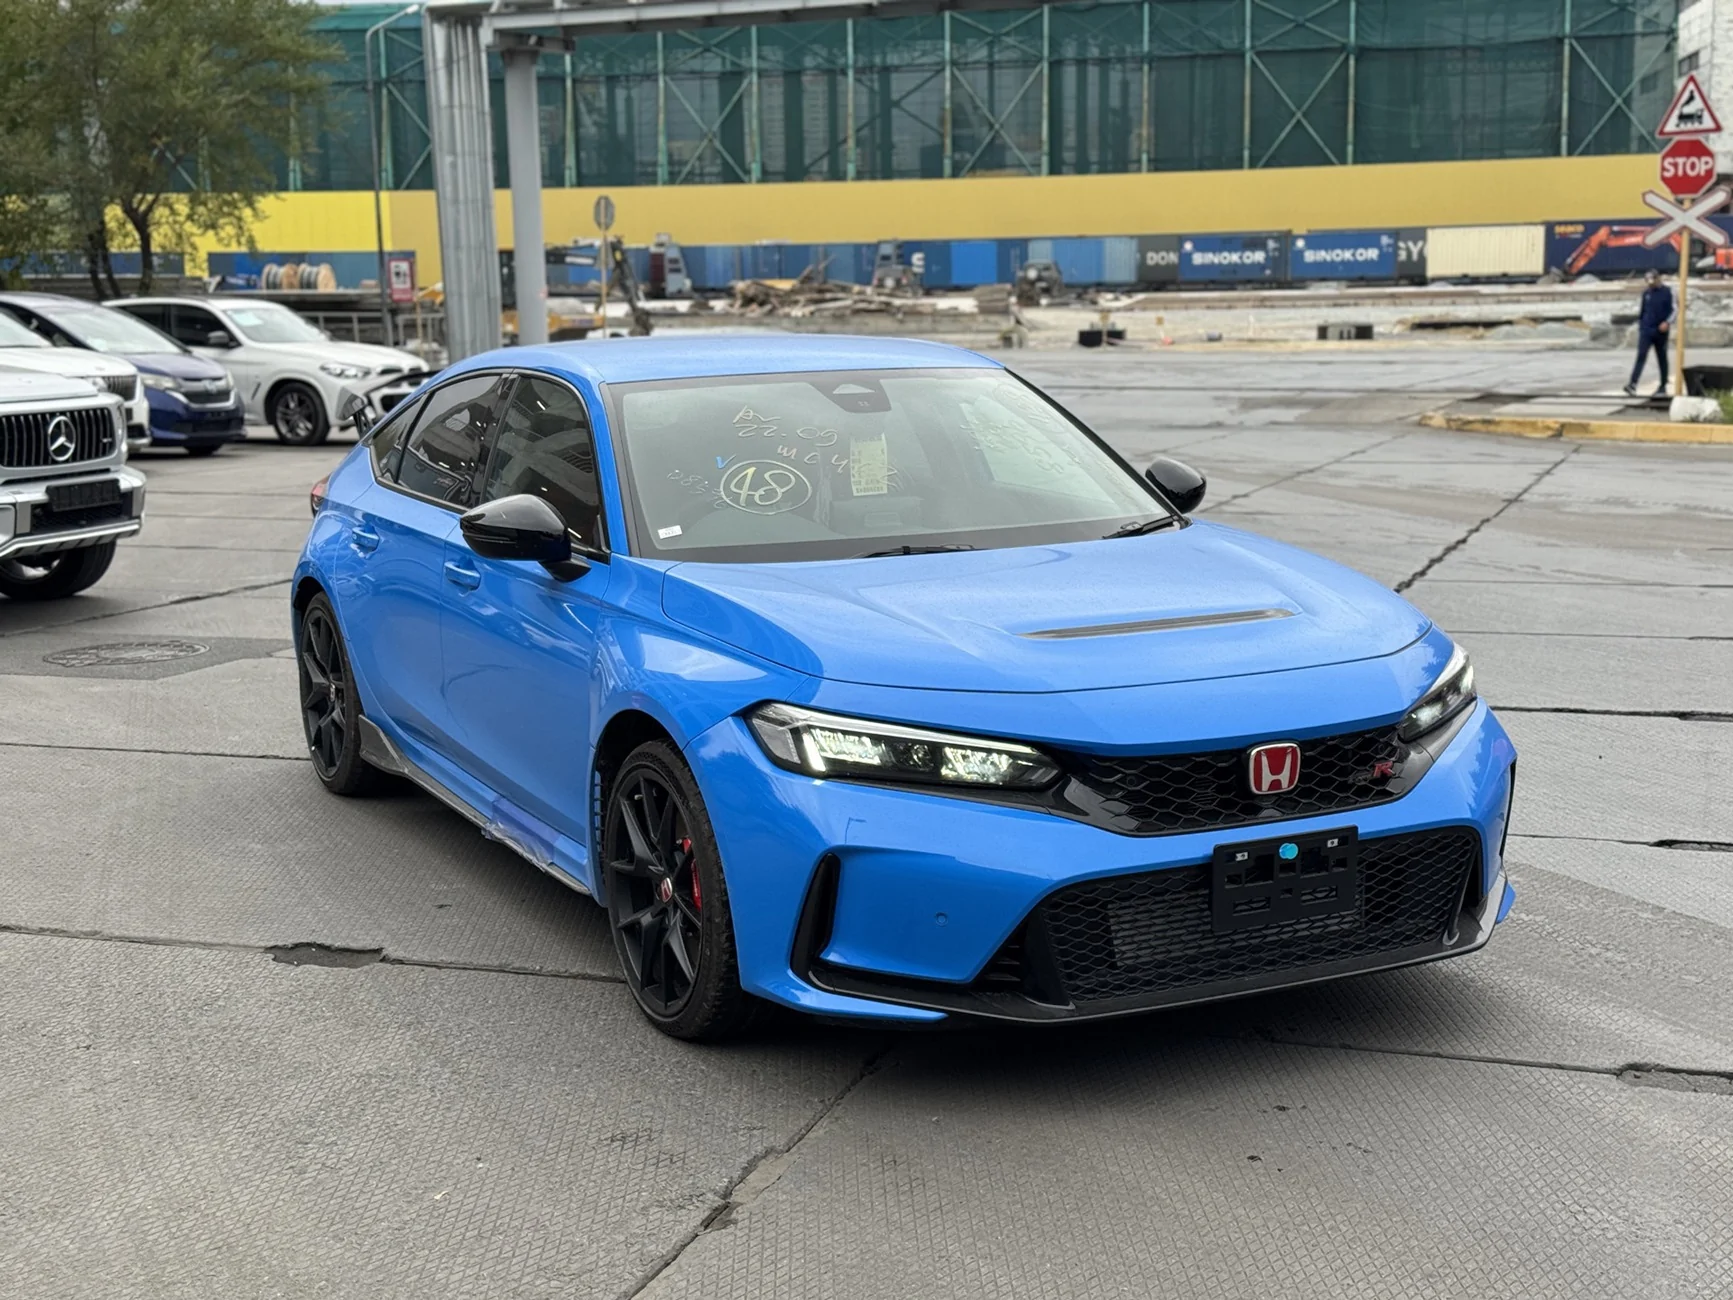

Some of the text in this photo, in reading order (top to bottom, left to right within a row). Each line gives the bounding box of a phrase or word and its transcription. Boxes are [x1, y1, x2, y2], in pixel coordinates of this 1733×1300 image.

[1662, 155, 1713, 178] STOP
[1192, 250, 1266, 266] SINOKOR
[1303, 247, 1379, 263] SINOKOR
